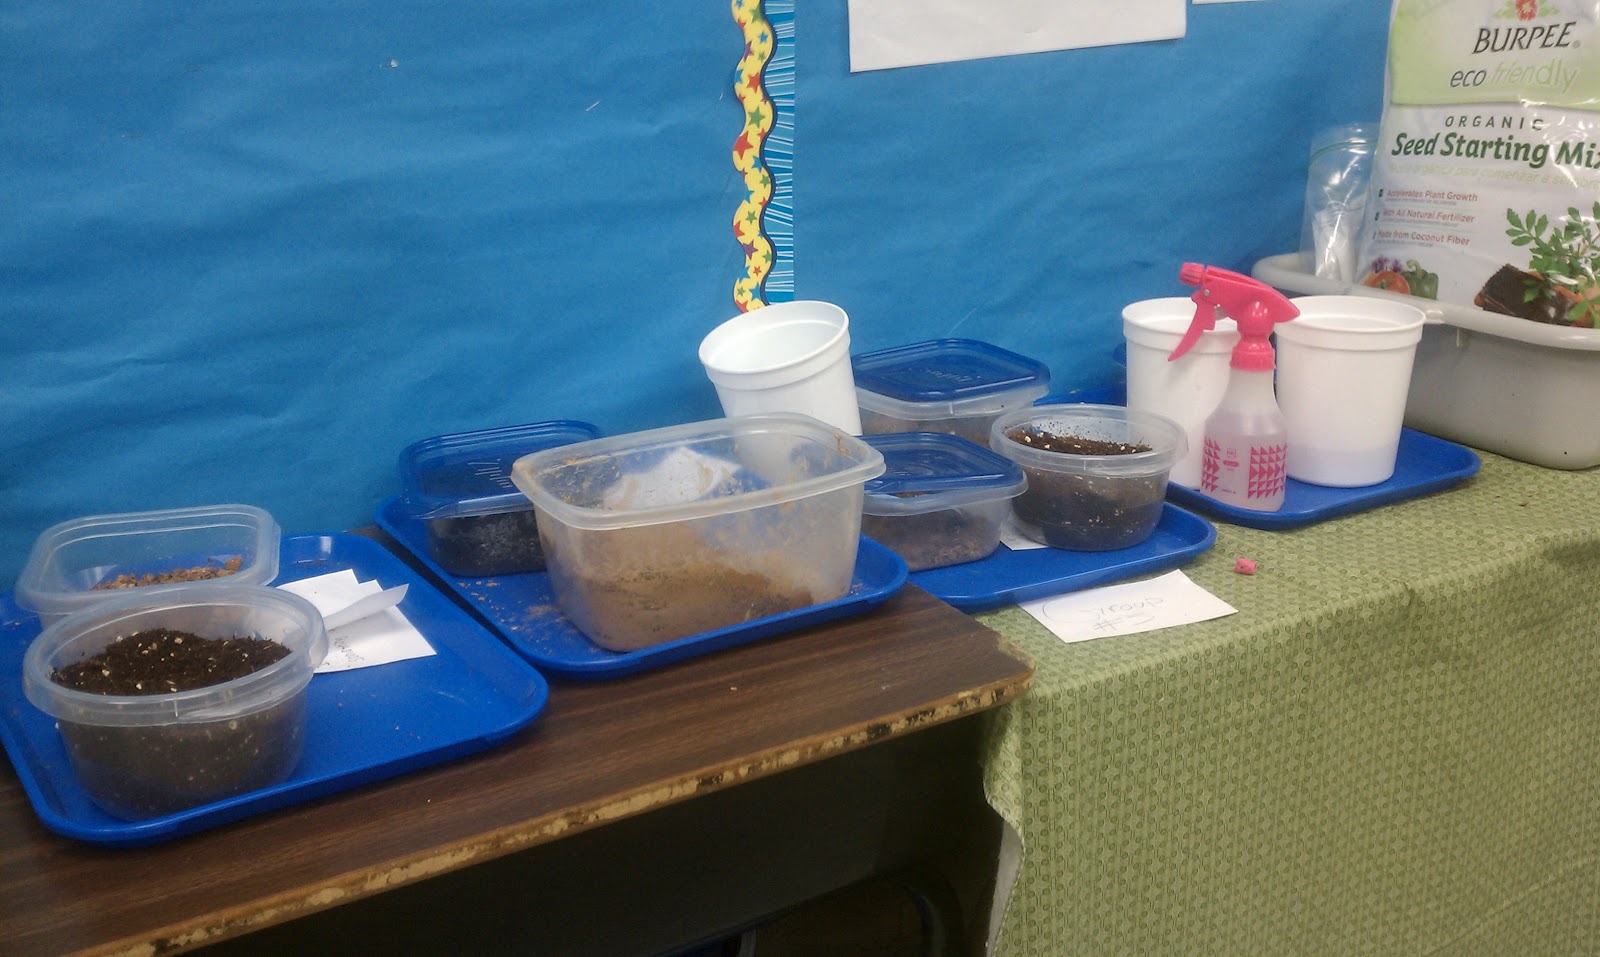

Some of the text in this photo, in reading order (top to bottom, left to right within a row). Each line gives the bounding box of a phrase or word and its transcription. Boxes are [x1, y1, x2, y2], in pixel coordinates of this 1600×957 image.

[1472, 21, 1577, 54] BURPEE
[1450, 59, 1578, 93] eco friendly
[1445, 115, 1544, 131] ORGANIC
[1391, 132, 1440, 156] Seed
[1440, 132, 1550, 169] Starting
[1424, 190, 1445, 200] Plant
[1446, 191, 1478, 202] Growth
[1407, 209, 1435, 220] Natural
[1436, 211, 1475, 223] Fertilizer
[1393, 230, 1409, 239] from
[1410, 231, 1445, 243] Coconut
[1446, 234, 1471, 246] Fiber
